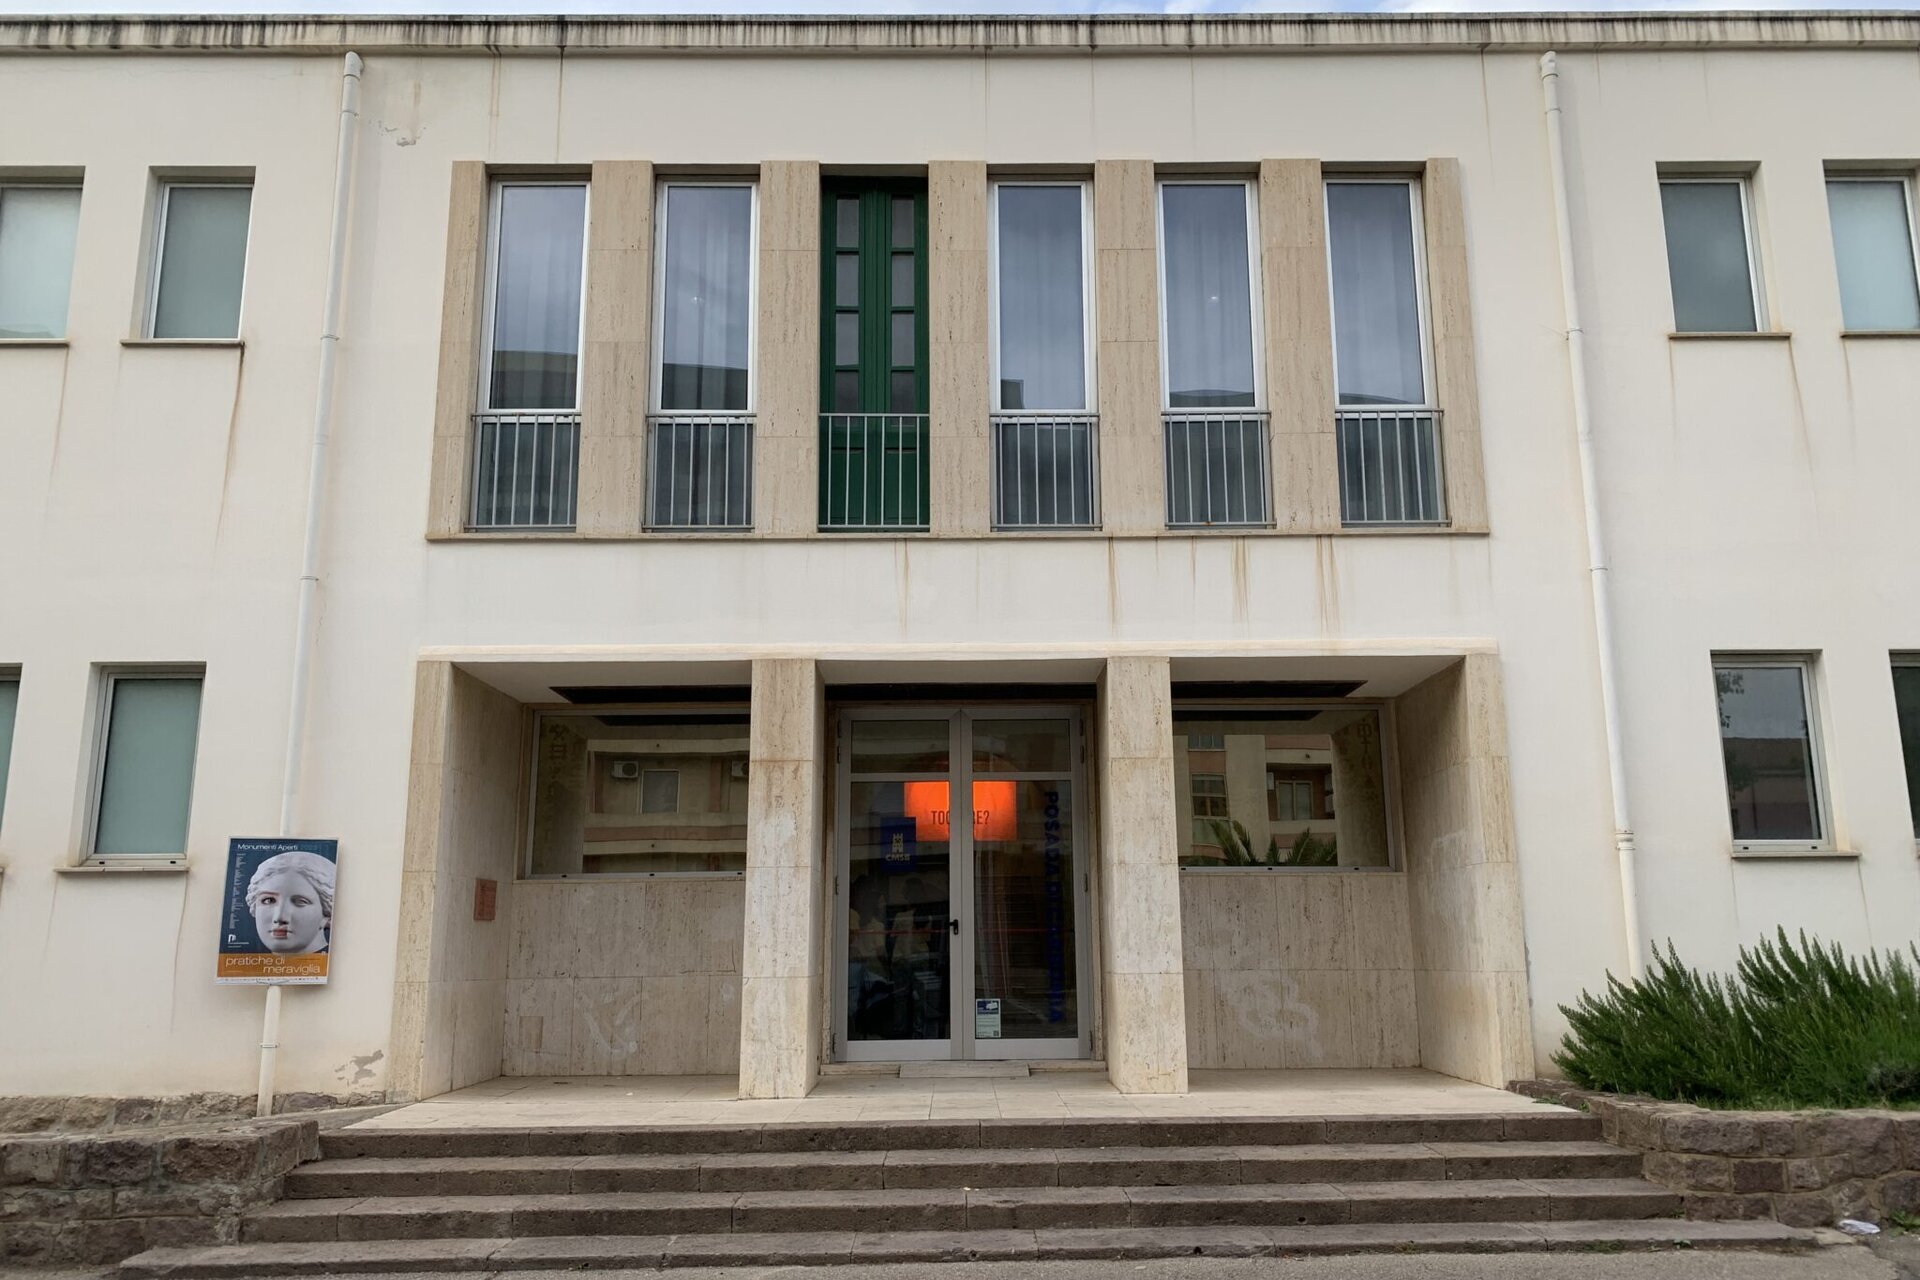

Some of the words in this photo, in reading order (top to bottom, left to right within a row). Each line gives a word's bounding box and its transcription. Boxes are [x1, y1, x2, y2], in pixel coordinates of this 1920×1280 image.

[1044, 791, 1060, 876] POSADA
[278, 843, 298, 851] Aperti
[225, 955, 274, 967] pratiche
[275, 955, 286, 965] di
[263, 964, 321, 976] meraviglia
